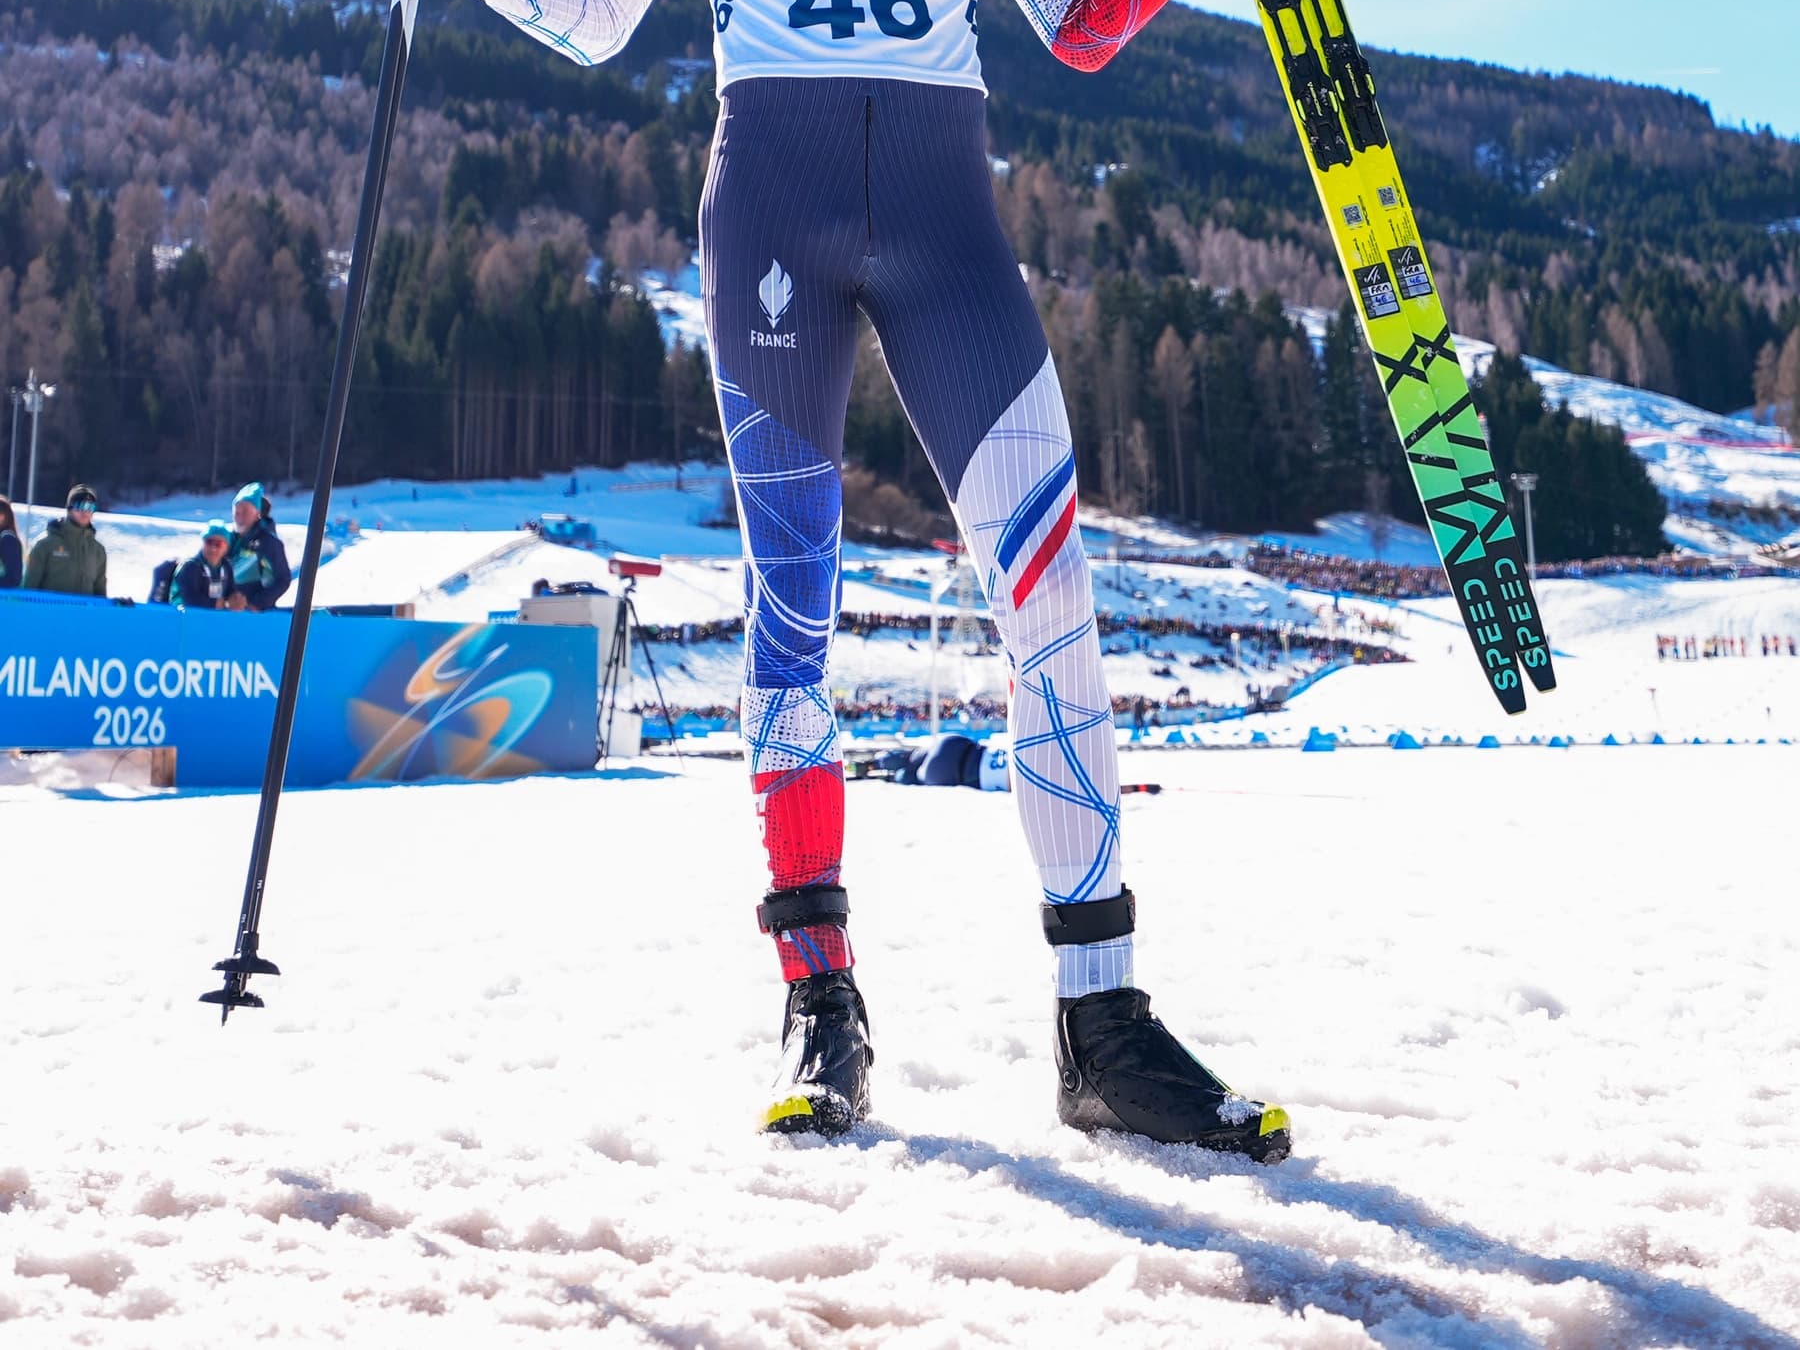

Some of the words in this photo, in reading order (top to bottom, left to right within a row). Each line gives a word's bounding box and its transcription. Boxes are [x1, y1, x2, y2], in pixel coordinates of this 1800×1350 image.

[750, 329, 797, 349] FRANCE
[134, 659, 279, 698] CORTINA
[92, 705, 166, 745] 2026
